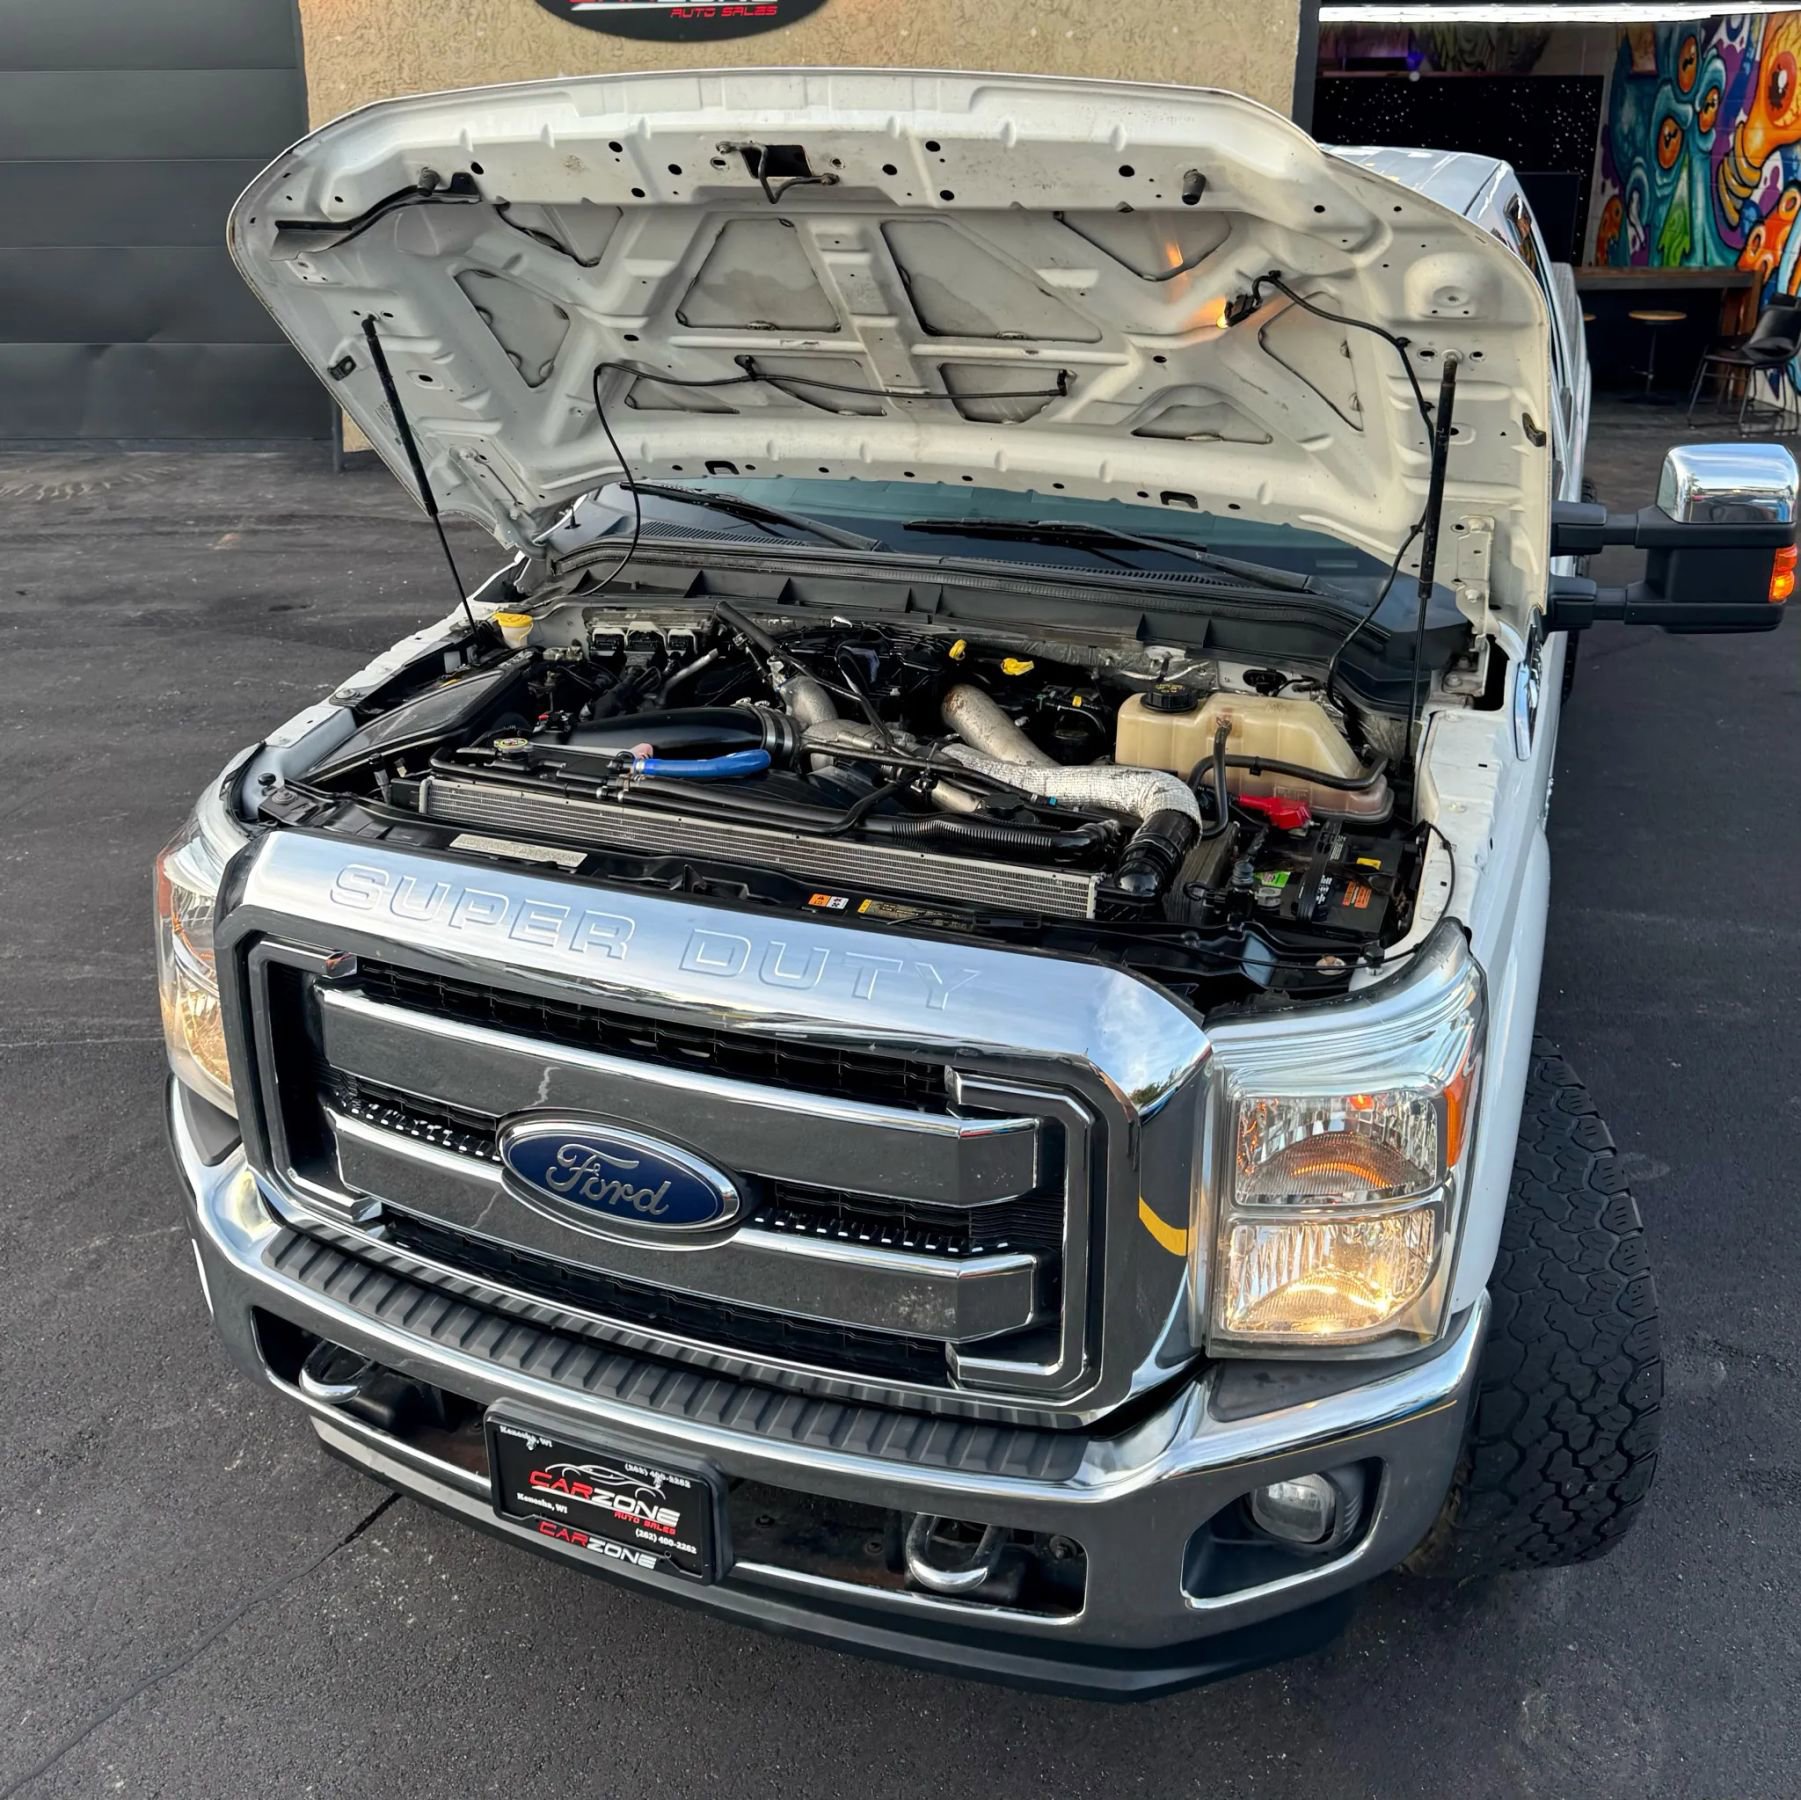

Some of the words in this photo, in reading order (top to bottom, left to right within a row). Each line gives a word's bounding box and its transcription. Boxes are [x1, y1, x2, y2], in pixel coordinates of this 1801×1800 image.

[670, 7, 716, 18] AUTO
[721, 6, 778, 17] SALES
[328, 863, 637, 962] SUPER
[678, 926, 981, 1011] DUTY
[545, 1143, 672, 1216] Ford
[516, 1492, 555, 1512] Kenosha,
[555, 1503, 568, 1514] WI
[529, 1470, 681, 1528] CARZONE
[613, 1510, 641, 1524] AUTO
[642, 1520, 677, 1536] SALES
[537, 1520, 658, 1570] CARZONE
